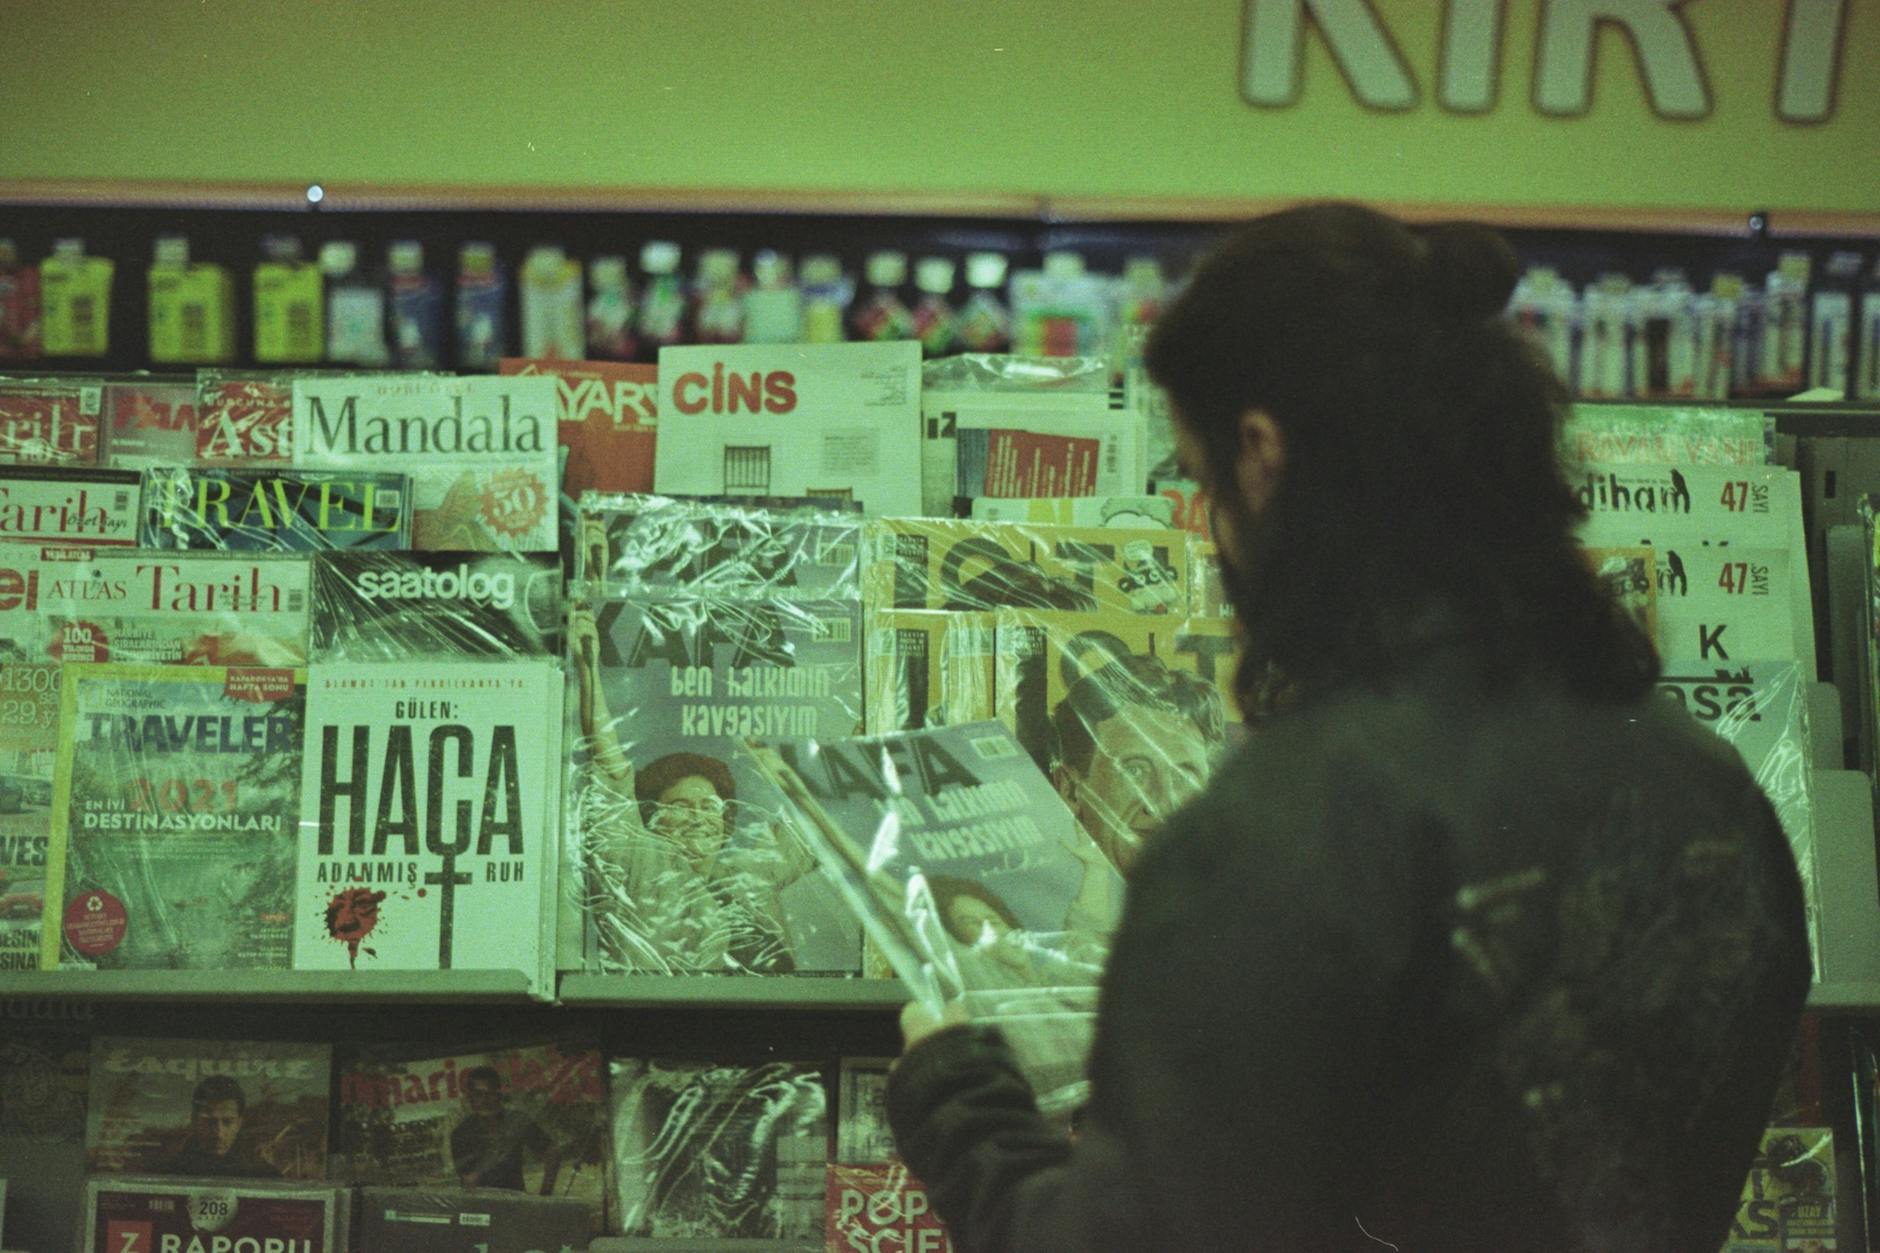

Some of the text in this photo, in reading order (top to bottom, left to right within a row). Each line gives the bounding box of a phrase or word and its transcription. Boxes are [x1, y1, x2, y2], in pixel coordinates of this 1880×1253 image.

[305, 396, 545, 454] Mandala
[155, 478, 400, 532] TRAVEL
[1720, 481, 1749, 512] 47
[46, 565, 282, 612] ATLAS Tarih
[358, 564, 515, 610] saatolog
[1717, 562, 1747, 594] 47
[395, 699, 459, 720] GÜLEN:
[84, 714, 291, 753] TRAVELER
[84, 813, 282, 832] DESTİNASYONLARI
[317, 862, 524, 889] ADANMIŞ RUH
[200, 1202, 229, 1217] 208
